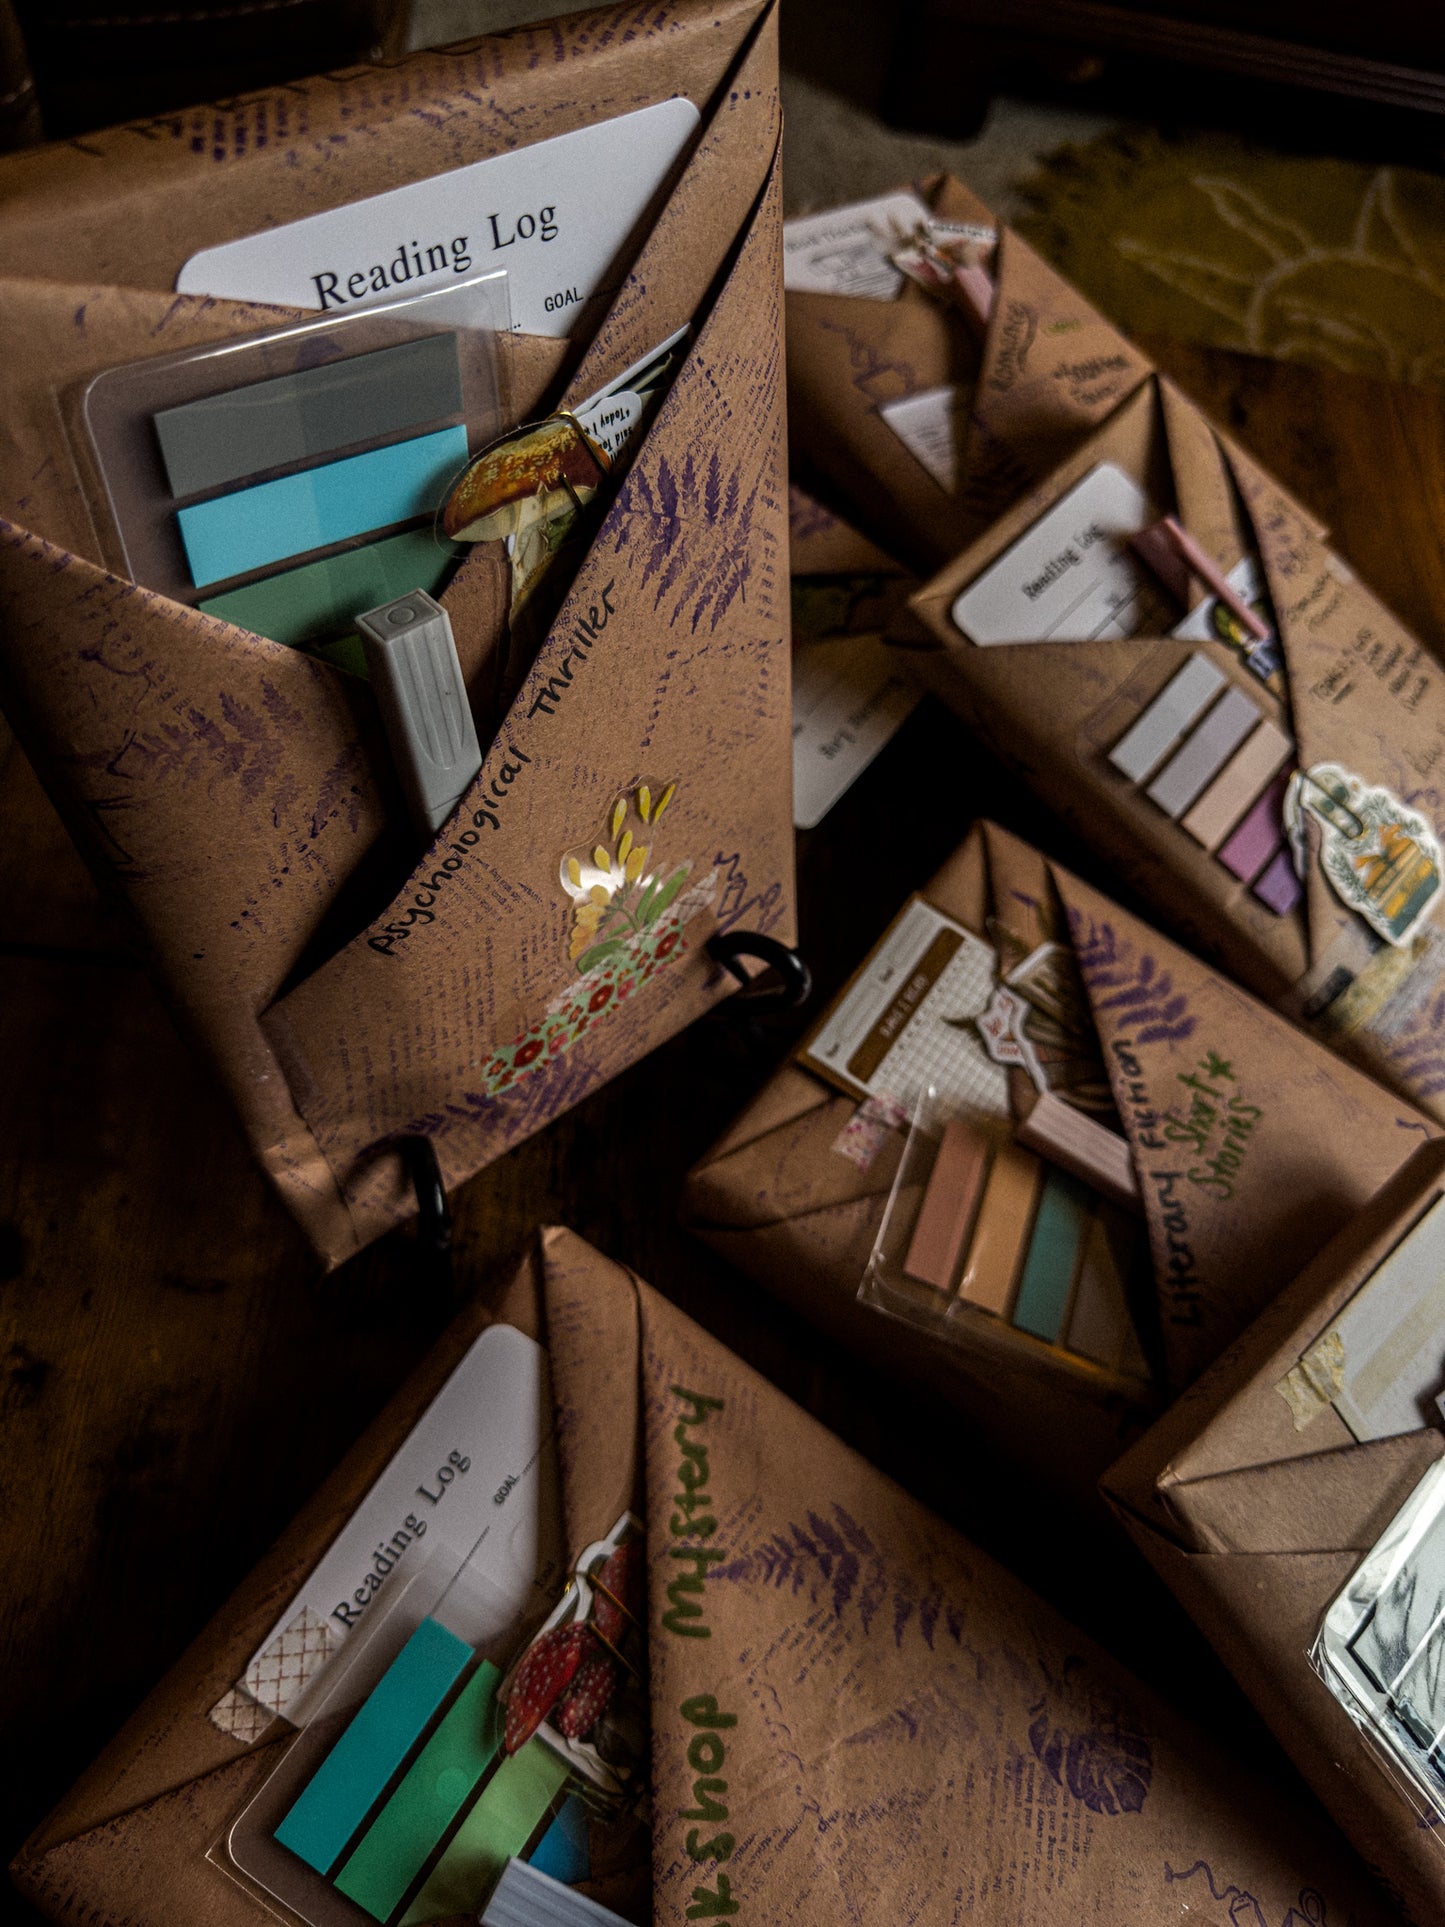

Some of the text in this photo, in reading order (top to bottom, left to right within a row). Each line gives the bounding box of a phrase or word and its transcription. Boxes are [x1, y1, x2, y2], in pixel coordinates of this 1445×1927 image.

[311, 205, 559, 311] Reading Log
[544, 287, 584, 313] GOAL
[526, 578, 616, 721] Thriller
[1112, 1039, 1166, 1150] Fiction
[1187, 1095, 1263, 1200] Stories
[332, 1448, 471, 1628] Reading Log
[494, 1473, 521, 1505] GOAL
